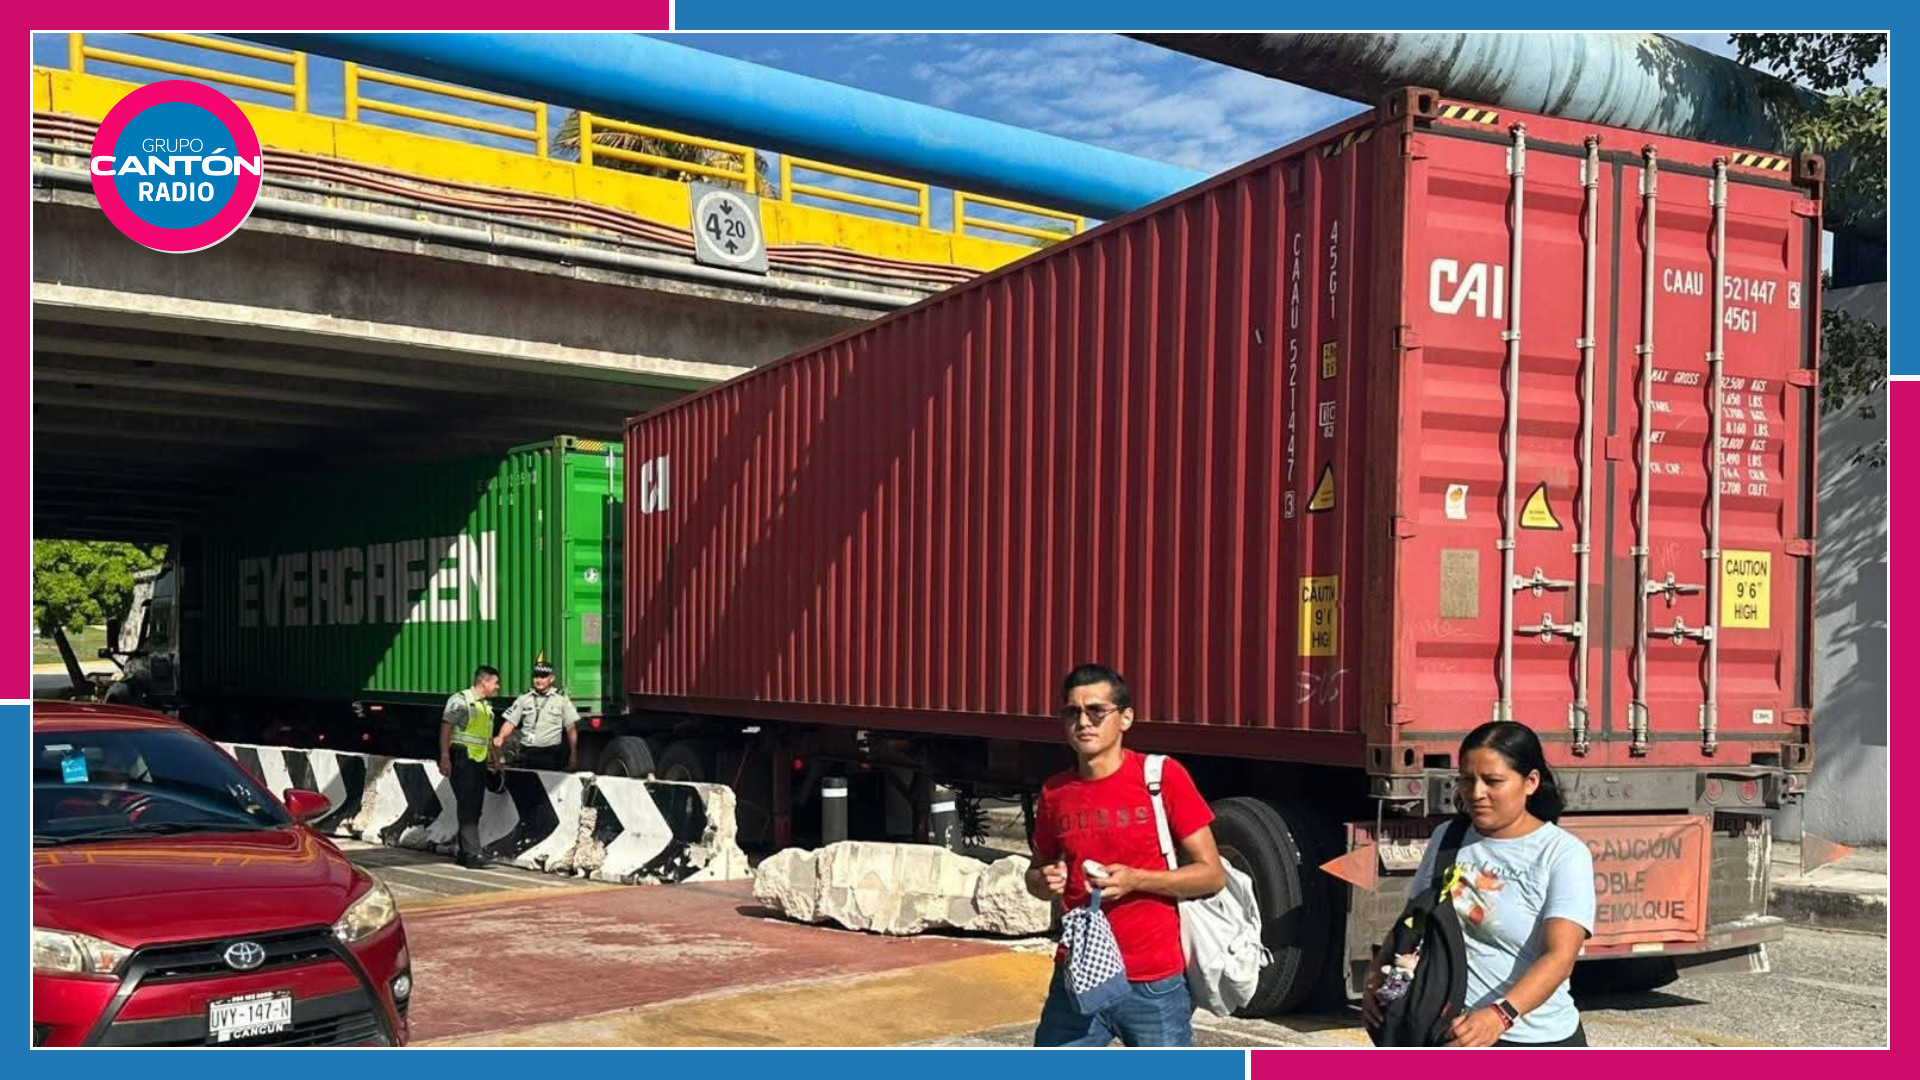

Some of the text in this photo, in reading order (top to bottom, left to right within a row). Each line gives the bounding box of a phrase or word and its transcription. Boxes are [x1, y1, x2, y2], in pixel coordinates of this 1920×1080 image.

[1291, 232, 1301, 329] CAAU
[1429, 257, 1504, 320] CAI
[1663, 268, 1704, 296] CAAU
[1723, 275, 1777, 306] 521447
[1724, 306, 1757, 334] 45G1
[237, 530, 496, 628] EVERGREEN
[1725, 559, 1768, 577] CAUTION
[1734, 602, 1758, 619] HIGH
[1594, 869, 1648, 896] OBLE
[1596, 900, 1685, 924] EMOLQUE
